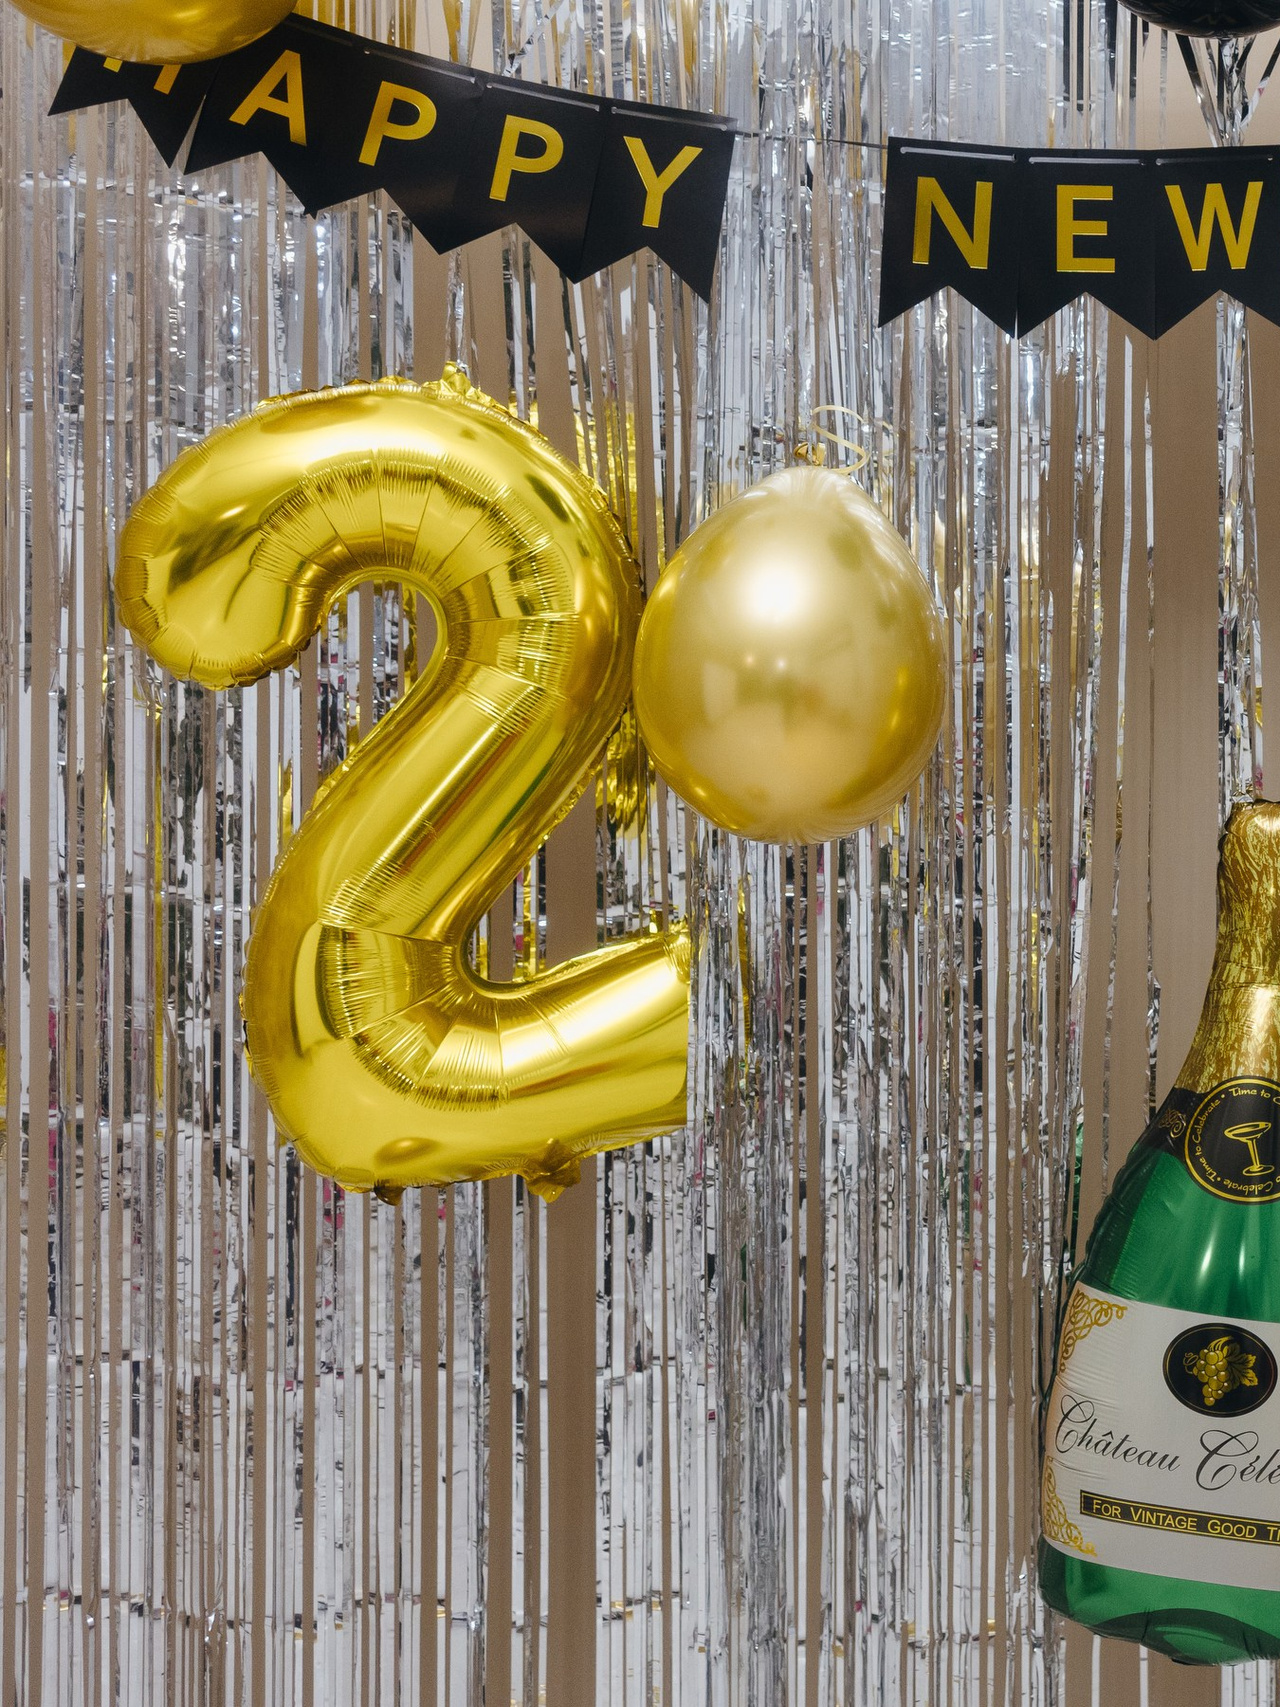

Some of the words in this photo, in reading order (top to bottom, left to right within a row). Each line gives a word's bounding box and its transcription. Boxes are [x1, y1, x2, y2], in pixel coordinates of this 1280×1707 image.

[103, 49, 702, 228] APPY
[912, 176, 1264, 273] NEW
[1229, 1086, 1257, 1097] Time
[1260, 1089, 1271, 1099] to
[1192, 1098, 1221, 1144] Celebrate
[1195, 1146, 1203, 1156] to
[1199, 1157, 1217, 1182] Time
[1223, 1178, 1274, 1196] Celebrate
[1055, 1394, 1181, 1472] Château
[1092, 1499, 1122, 1518] FOR
[1130, 1506, 1198, 1531] VINTAGE
[1207, 1518, 1257, 1540] GOOD
